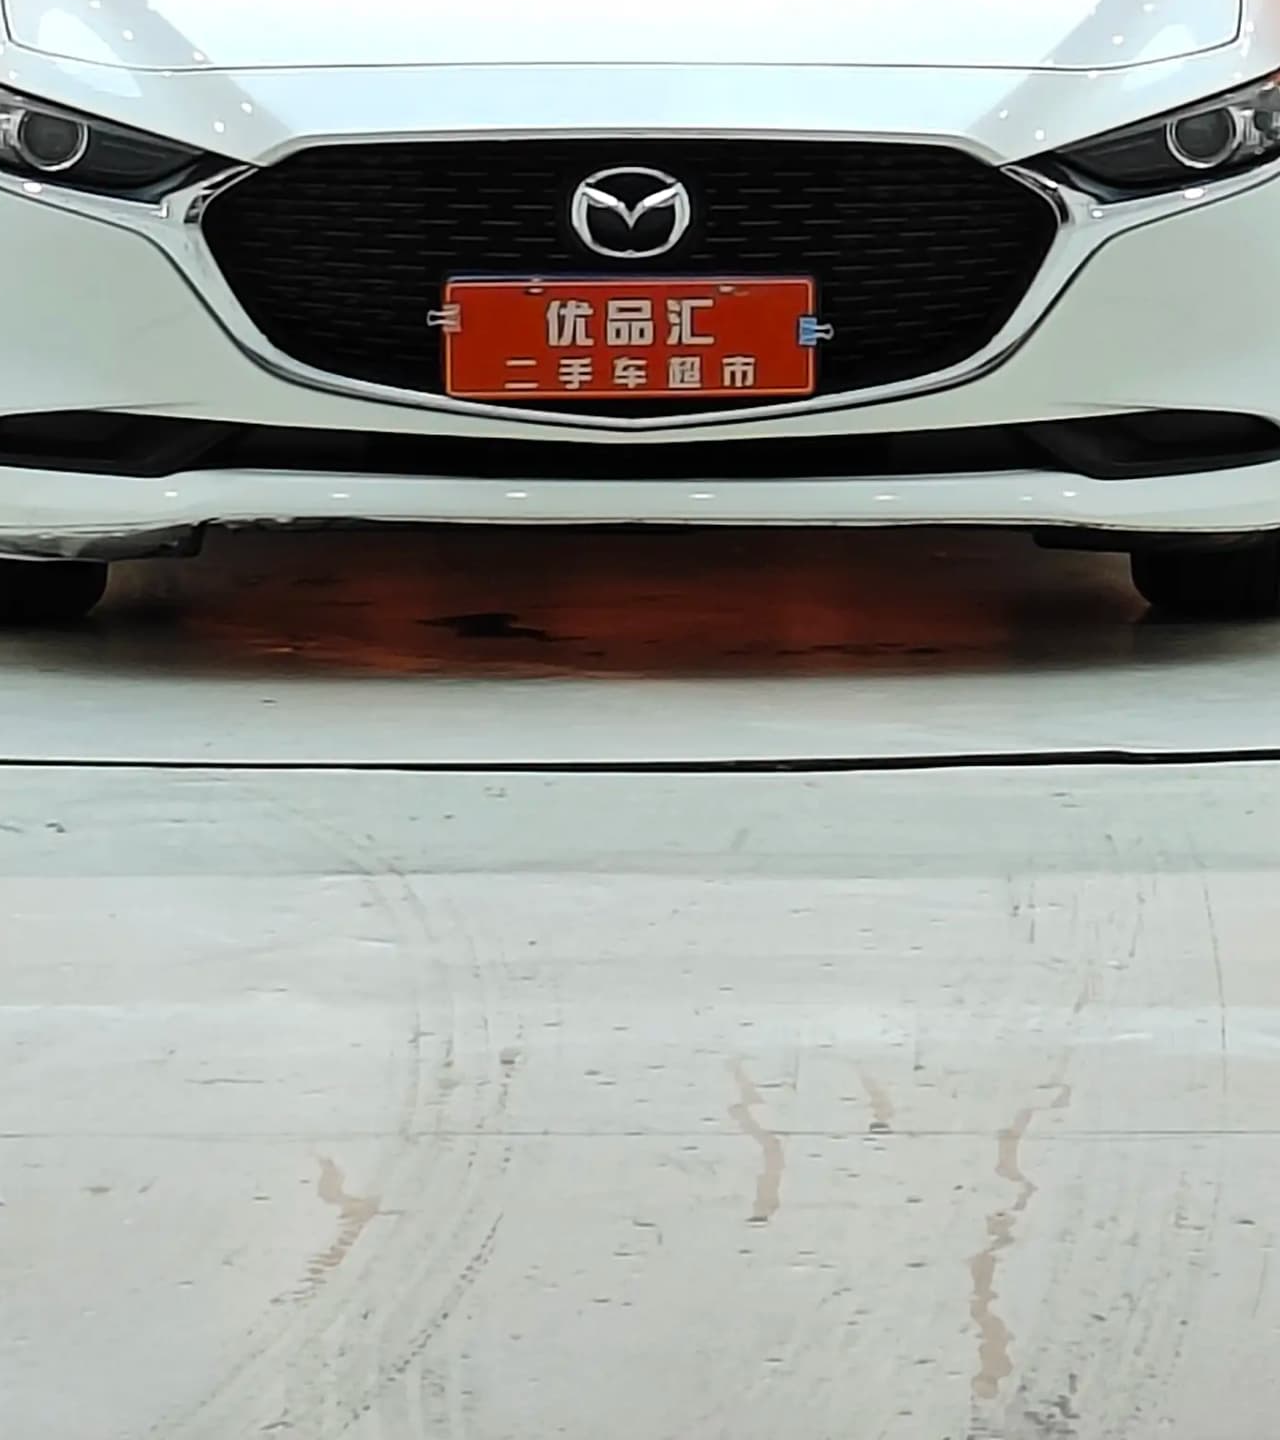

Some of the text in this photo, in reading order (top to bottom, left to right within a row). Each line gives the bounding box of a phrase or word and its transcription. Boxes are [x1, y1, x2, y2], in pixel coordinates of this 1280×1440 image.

[547, 299, 714, 346] 优品汇
[505, 357, 755, 389] 二手车超市
